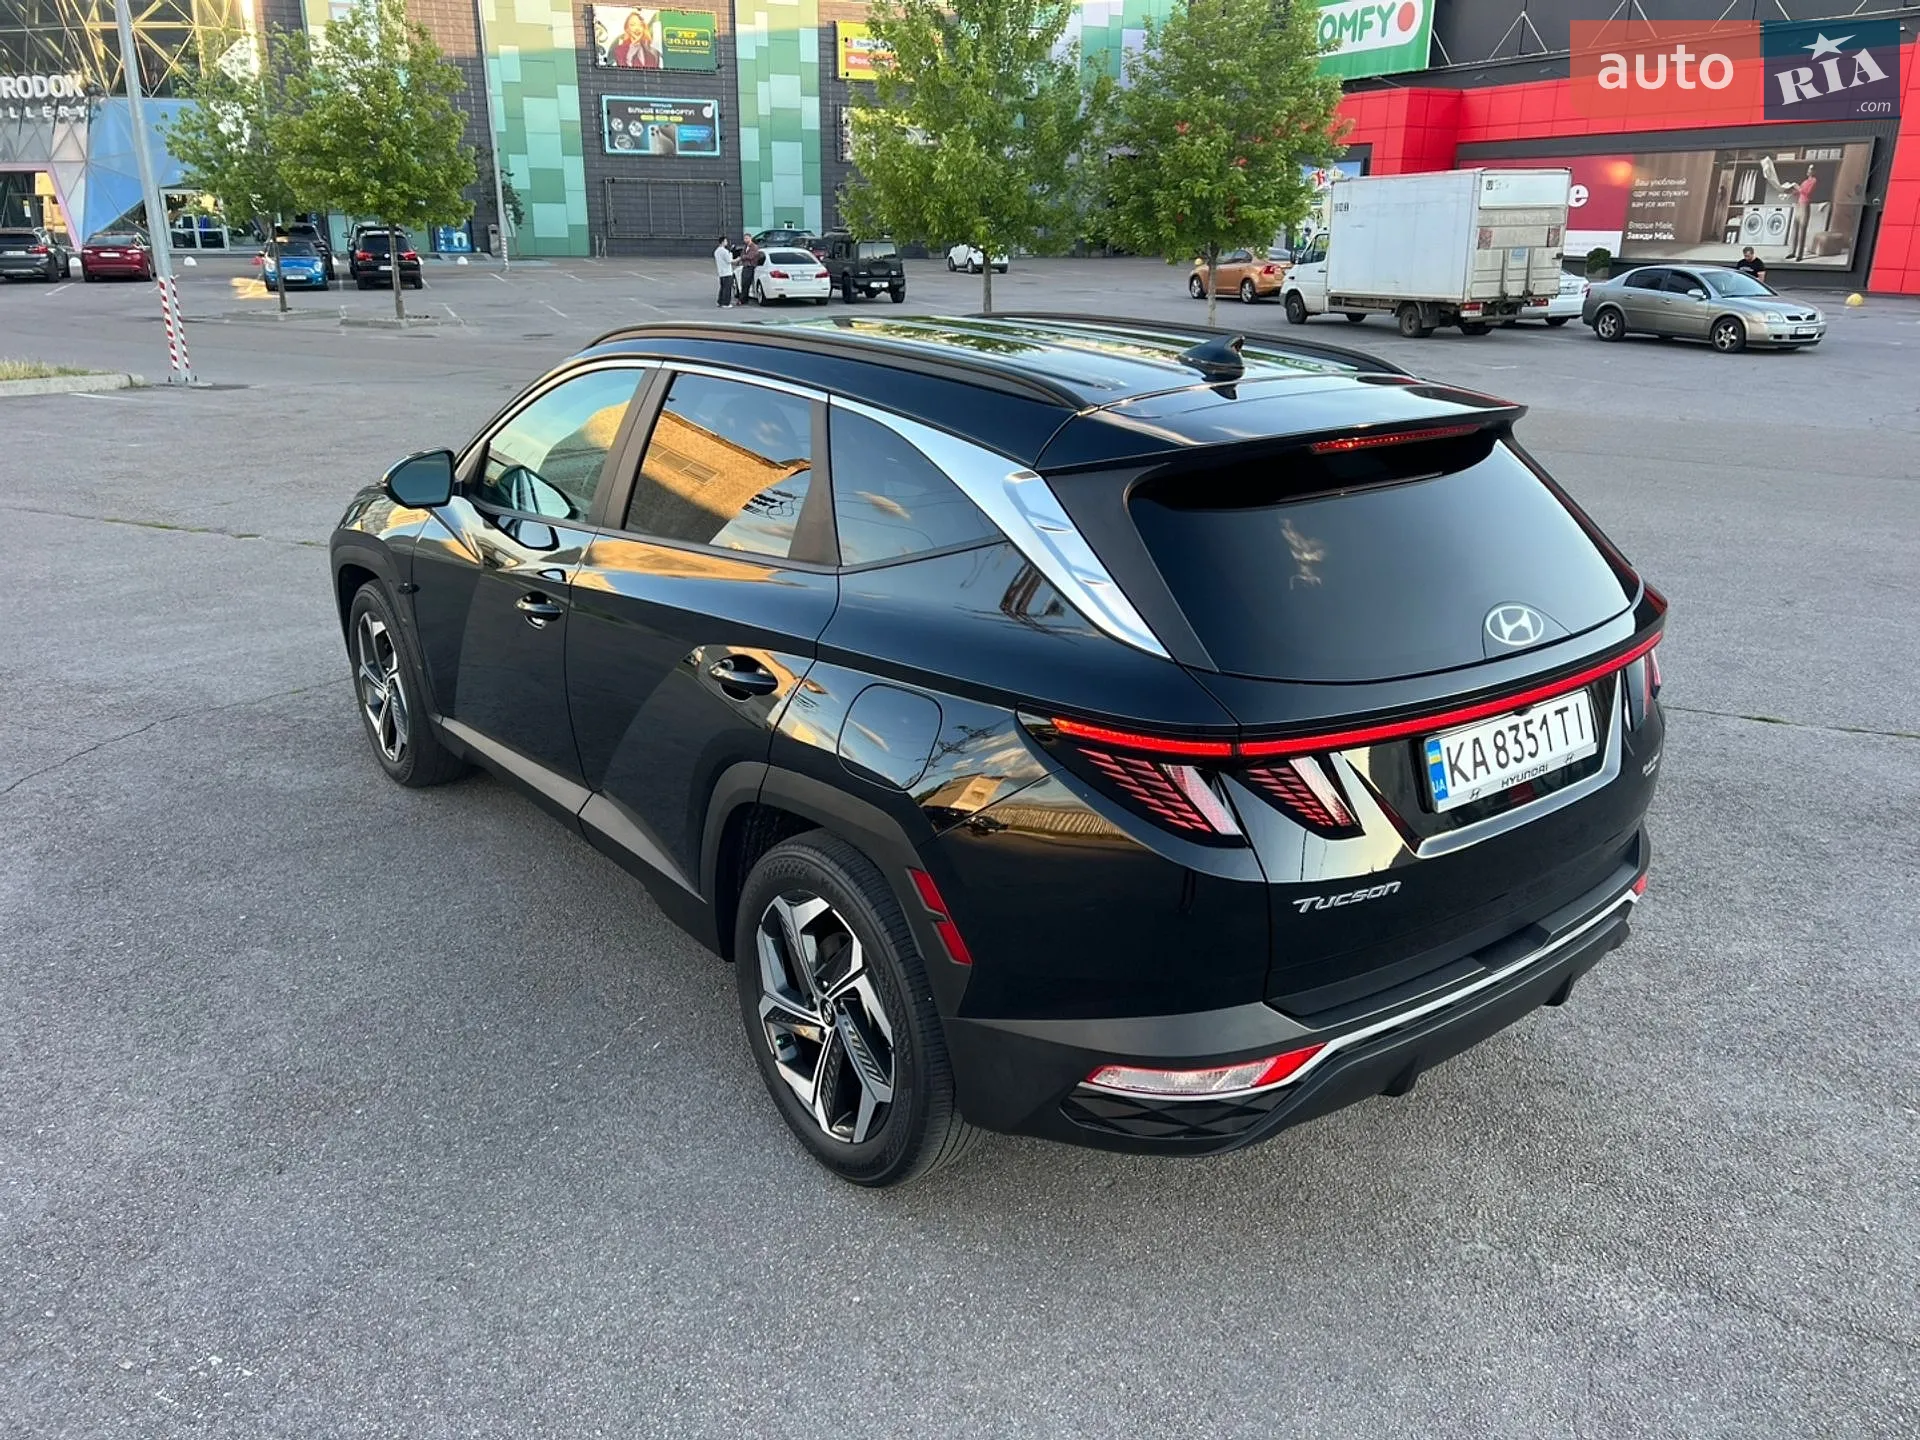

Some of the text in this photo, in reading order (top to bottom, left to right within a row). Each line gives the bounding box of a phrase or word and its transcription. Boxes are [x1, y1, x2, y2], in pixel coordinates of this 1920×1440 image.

[1319, 2, 1396, 45] OMFY
[0, 74, 86, 99] RODOK
[0, 105, 87, 119] LLERY
[1432, 779, 1447, 793] UA
[1501, 763, 1549, 788] HYUNDAI
